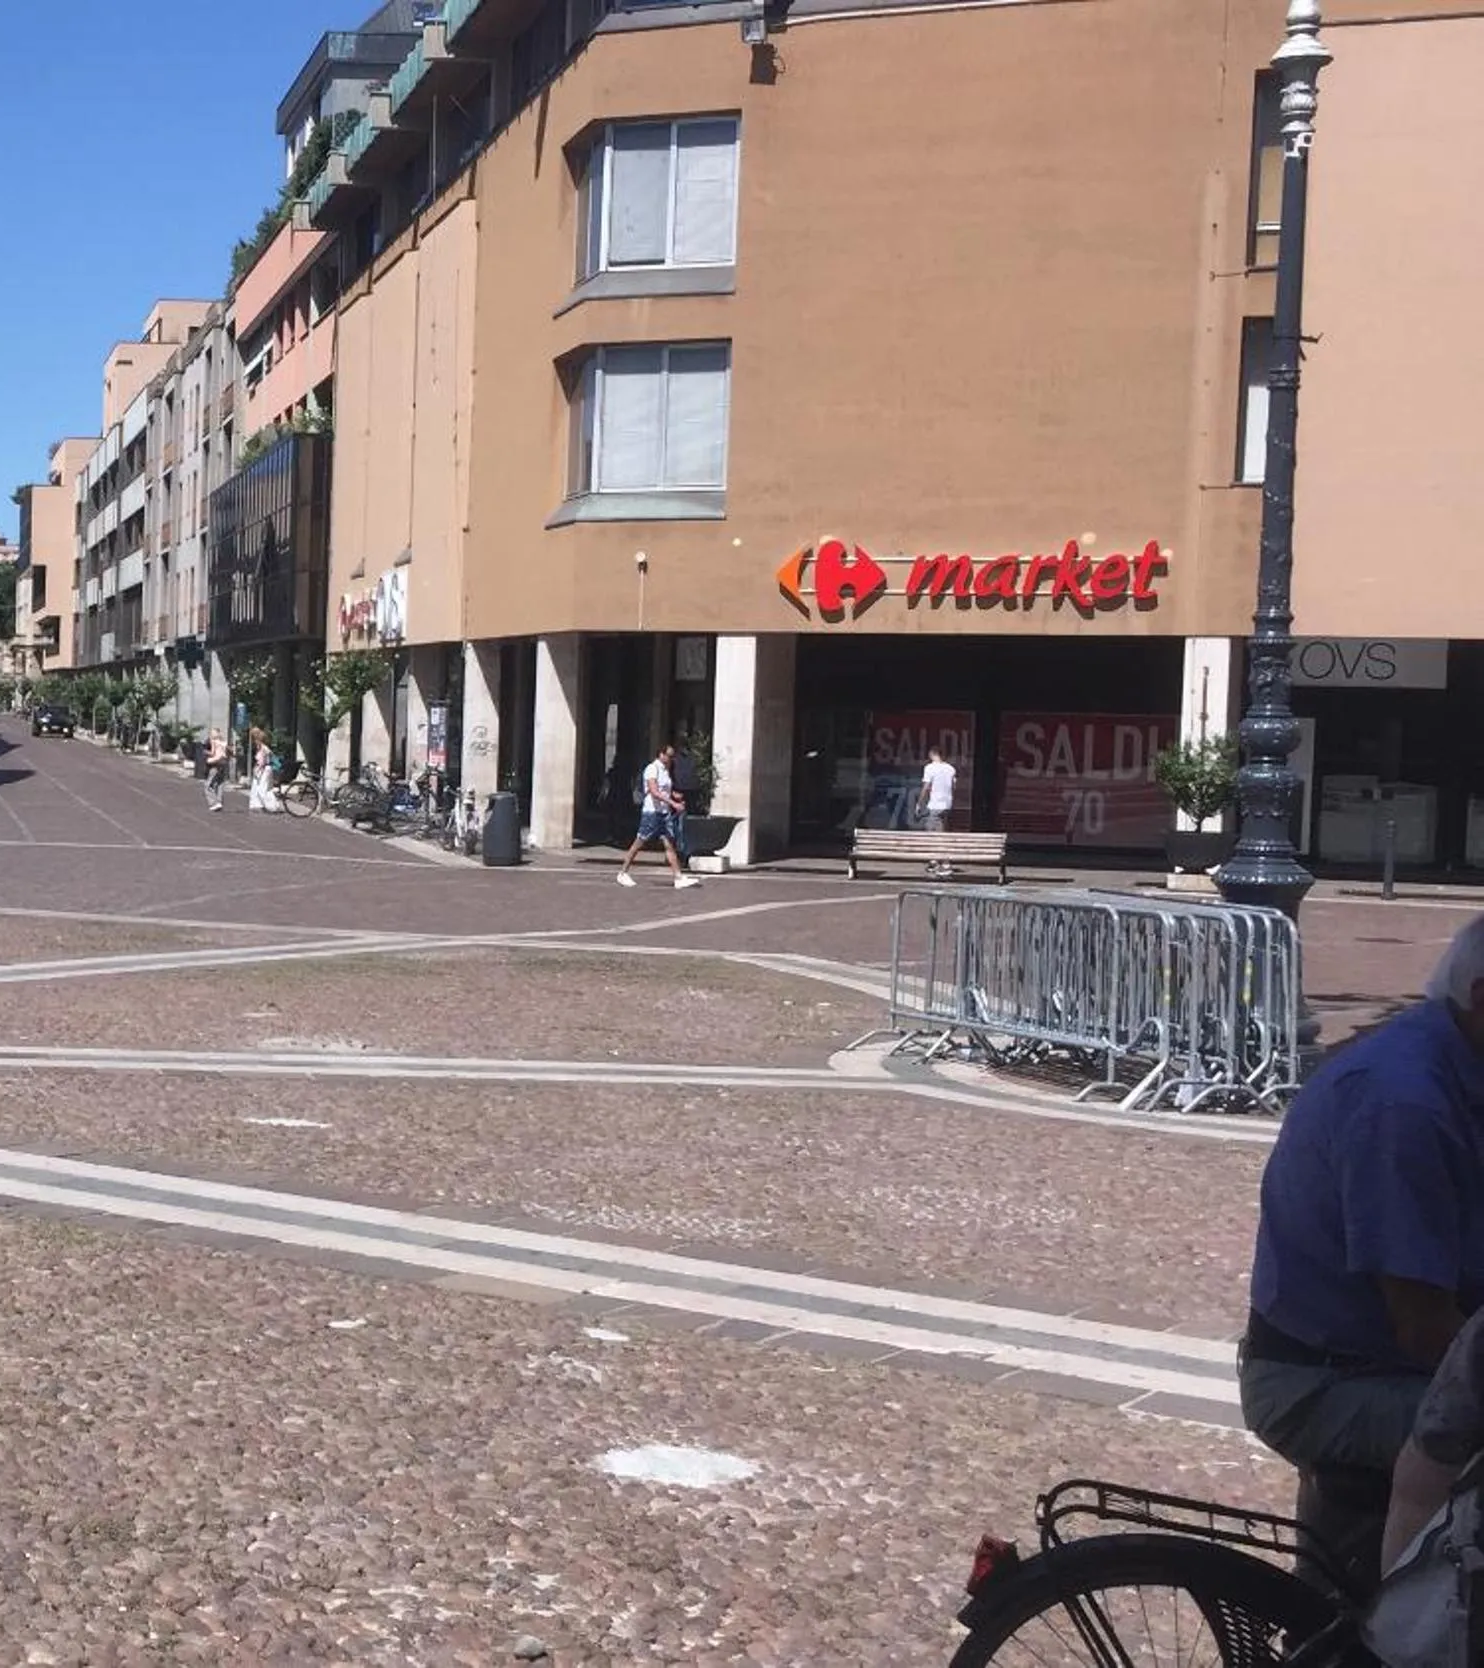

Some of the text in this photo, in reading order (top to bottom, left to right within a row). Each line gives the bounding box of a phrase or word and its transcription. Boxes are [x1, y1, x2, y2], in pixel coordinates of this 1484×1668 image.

[905, 540, 1168, 607] market
[1299, 640, 1397, 681] OVS
[872, 727, 970, 766] SALDI
[1013, 722, 1159, 782] SALDI
[1062, 788, 1106, 834] 70
